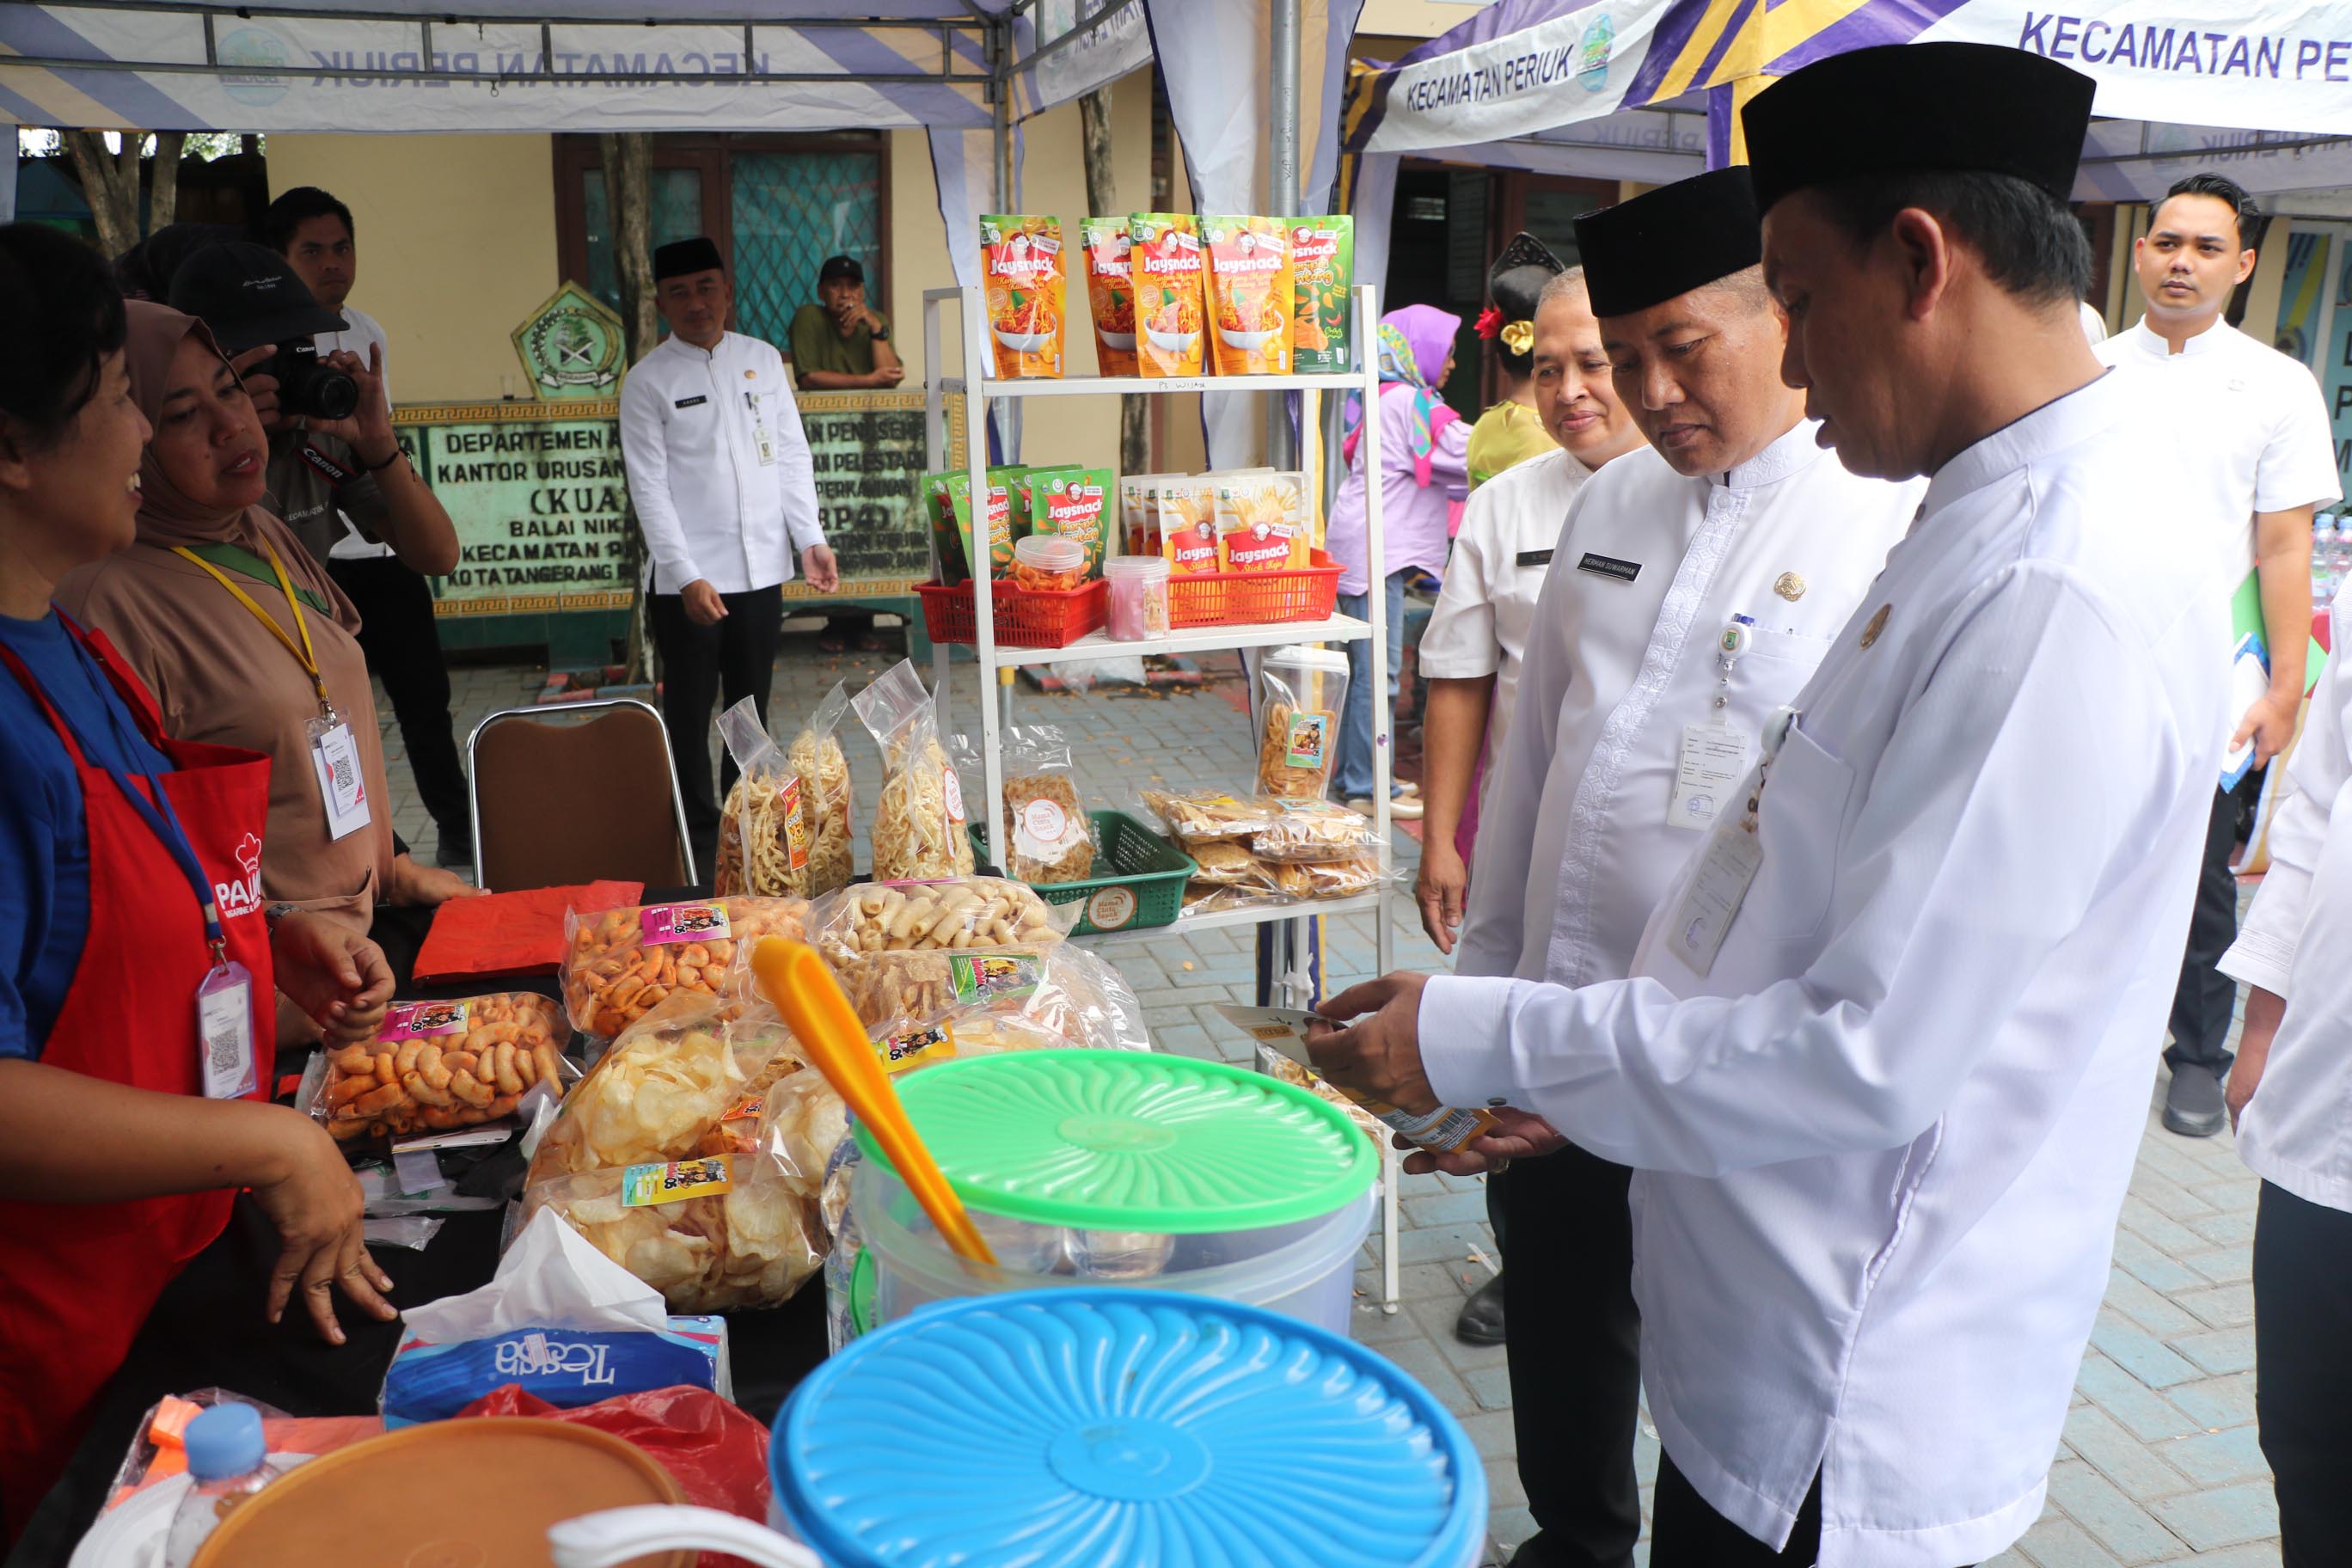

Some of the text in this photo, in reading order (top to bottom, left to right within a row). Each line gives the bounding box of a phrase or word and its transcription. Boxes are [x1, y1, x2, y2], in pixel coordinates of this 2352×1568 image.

[2018, 11, 2285, 78] KECAMATAN
[1407, 43, 1575, 112] KECAMATAN PERIUK
[1292, 242, 1338, 258] ysnack
[990, 256, 1054, 275] Jaysnack
[1093, 260, 1133, 275] Jaysn
[1143, 254, 1201, 273] Jaysnack
[1213, 254, 1283, 273] Jaysnack
[1293, 270, 1332, 285] ntang
[446, 430, 602, 454] DEPARTEMEN
[303, 447, 343, 478] Canon
[438, 459, 626, 483] KANTOR URUSAN
[286, 504, 324, 521] ECAMATAN
[1048, 499, 1103, 520] Jaysnack
[510, 520, 574, 537] BALAI
[462, 542, 600, 563] KECAMATAN
[1175, 546, 1218, 562] Jaysna
[1229, 542, 1290, 563] Jaysnack
[448, 568, 501, 586] KOTA
[504, 564, 612, 585] TANGERANG
[1583, 557, 1636, 575] HERMAN SUWARMAN
